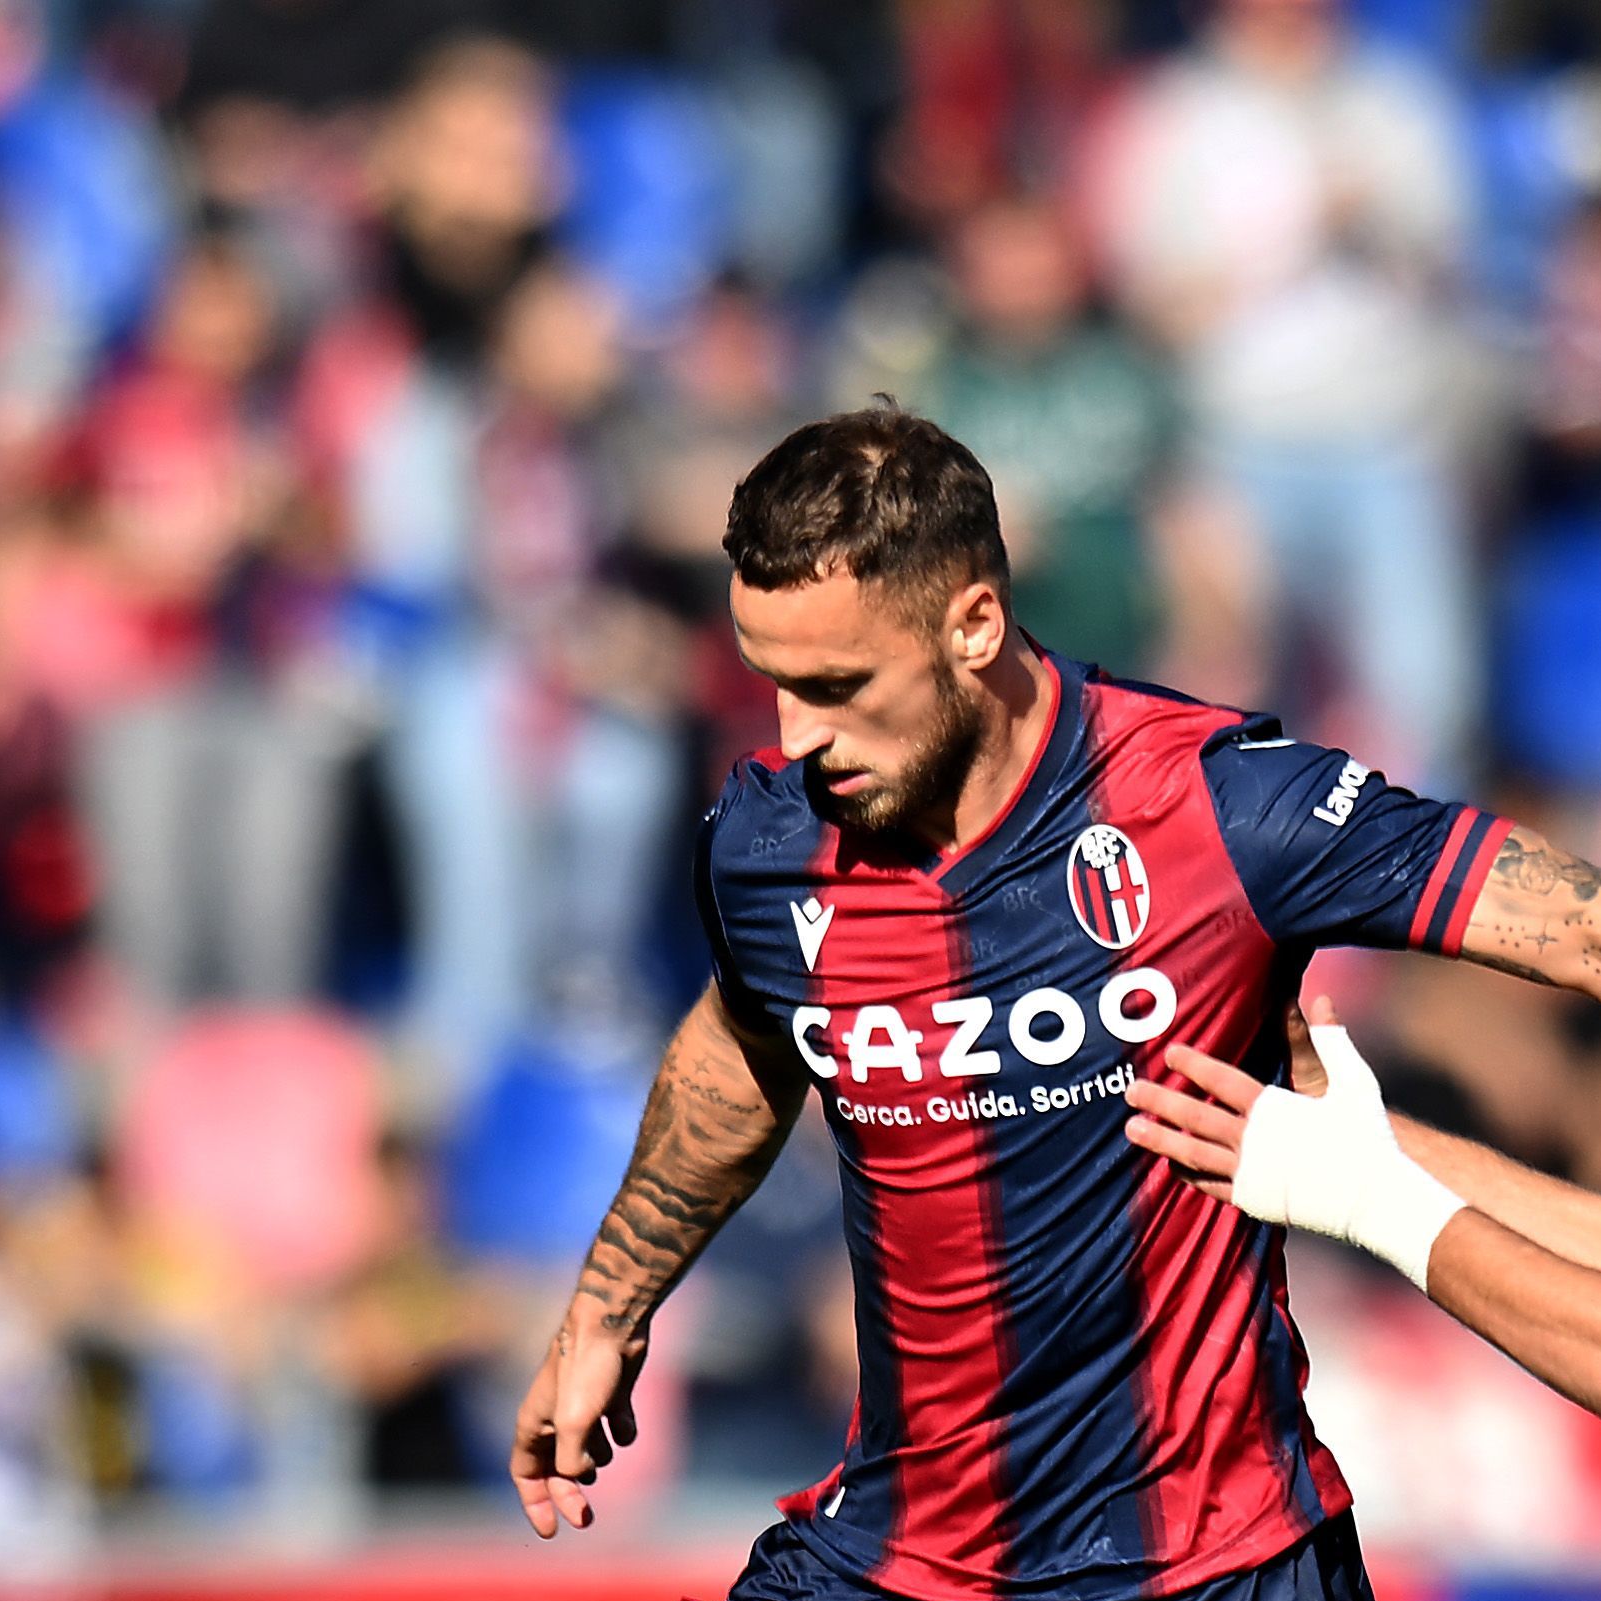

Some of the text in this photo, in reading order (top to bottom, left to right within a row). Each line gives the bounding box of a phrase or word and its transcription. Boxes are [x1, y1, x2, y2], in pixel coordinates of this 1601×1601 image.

[792, 966, 1177, 1083] CAZOO
[837, 1096, 922, 1127] Cerca.
[926, 1089, 1026, 1123] Guida.
